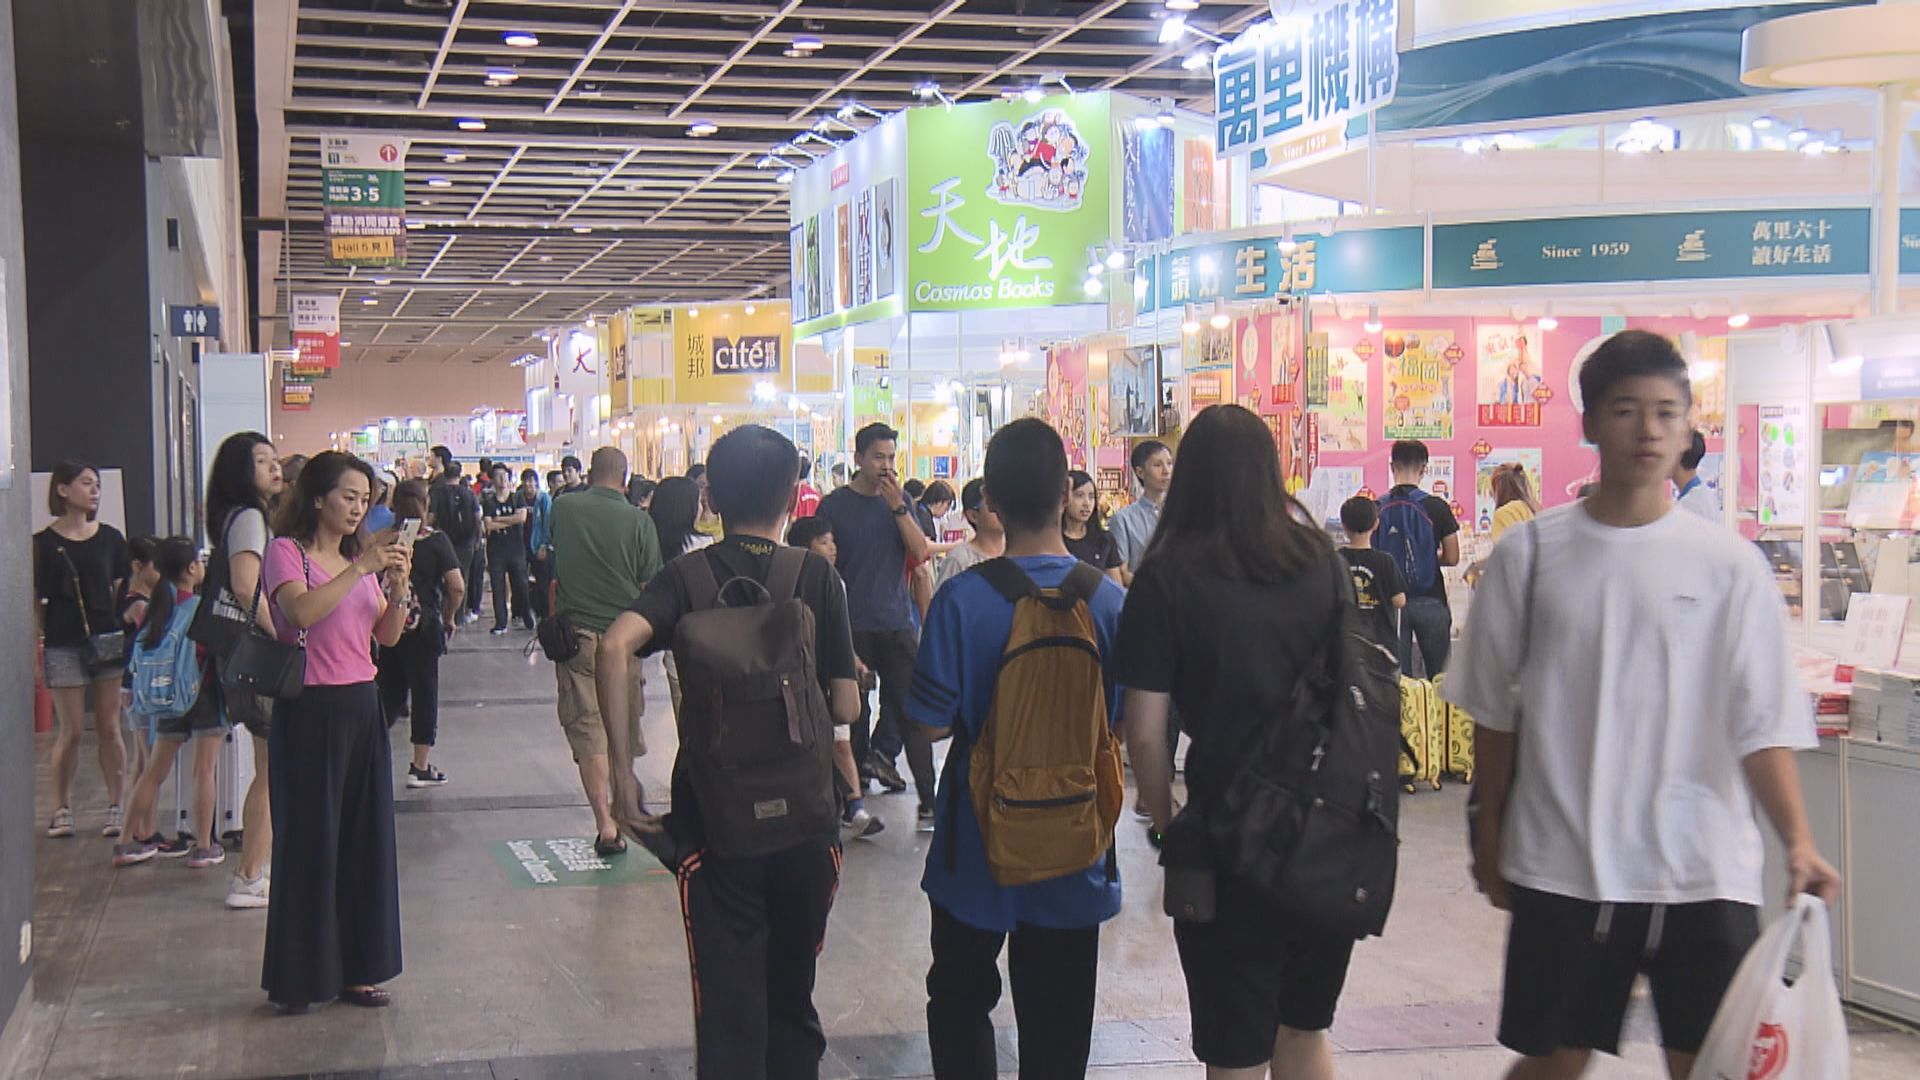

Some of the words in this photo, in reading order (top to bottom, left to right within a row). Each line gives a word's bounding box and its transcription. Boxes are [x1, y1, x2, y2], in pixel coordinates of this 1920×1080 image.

[1217, 0, 1394, 153] 萬里機構
[918, 176, 1054, 281] 天地
[1752, 219, 1833, 241] 萬里六十
[1541, 244, 1582, 260] Since
[1590, 242, 1630, 257] 1959
[1752, 244, 1833, 267] 讀好生活
[915, 280, 993, 303] Cosmos
[998, 275, 1054, 299] Books
[687, 334, 705, 379] 城邦
